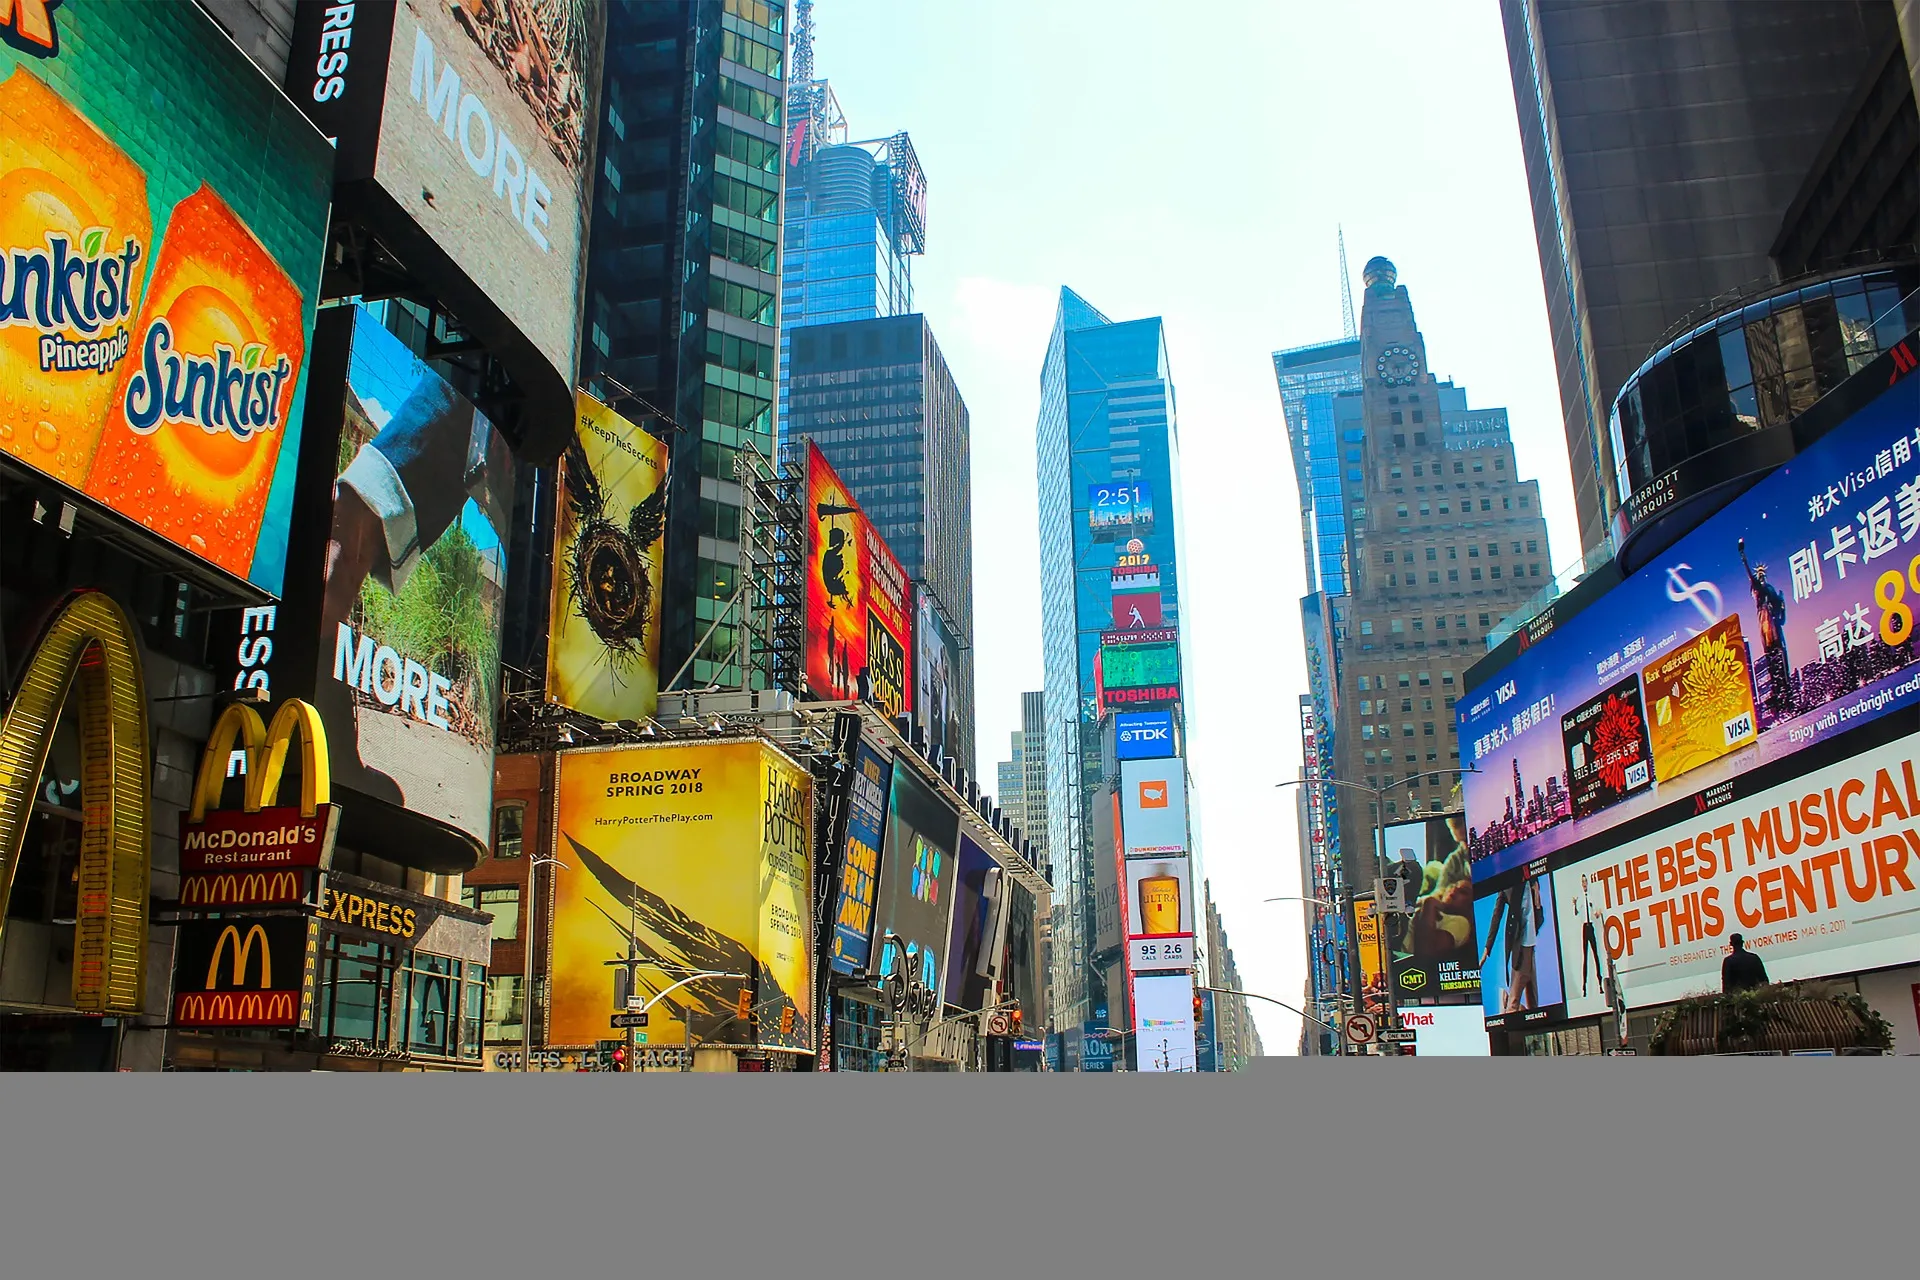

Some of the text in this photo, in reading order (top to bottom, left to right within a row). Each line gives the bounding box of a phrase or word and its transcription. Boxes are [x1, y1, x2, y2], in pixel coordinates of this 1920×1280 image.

[313, 0, 355, 102] RESS
[410, 25, 551, 254] MORE
[40, 328, 129, 375] Pineapple
[125, 322, 290, 436] Sunkist
[580, 414, 659, 471] #KeepTheSecrets
[1097, 486, 1141, 506] 2:51
[1629, 470, 1679, 510] MARRIOTT
[1632, 489, 1675, 524] MARQUIS
[1112, 564, 1159, 575] TOSHIBA
[1119, 554, 1150, 567] 2017
[1529, 607, 1555, 631] MARRIOTT
[1530, 620, 1554, 642] MARQUIS
[1815, 603, 1874, 664] 高达
[333, 621, 451, 731] MORE
[1104, 687, 1179, 703] TOSHIBA
[1496, 680, 1516, 704] VISA
[725, 714, 761, 723] LAMAR
[1789, 723, 1815, 742] Enjoy
[1816, 711, 1839, 732] with
[1839, 688, 1894, 721] Everbright
[1131, 728, 1168, 741] TDK
[1725, 718, 1750, 739] VISA
[609, 768, 702, 783] BROADWAY
[1627, 765, 1646, 784] VISA
[606, 782, 703, 798] SPRING 2018
[767, 765, 807, 826] HARRY
[1706, 781, 1733, 798] MARRIOTT
[1707, 792, 1732, 808] MARQUIS
[594, 813, 713, 827] HarryPotterThePlay.com
[184, 825, 316, 850] McDonald's
[764, 801, 809, 862] POTTER
[205, 849, 291, 864] Restaurant
[847, 836, 877, 878] COME
[1655, 822, 1735, 893] BEST
[1144, 893, 1177, 904] ULTRA
[315, 888, 416, 938] EXPRESS
[838, 896, 871, 935] AWAY
[1358, 922, 1374, 932] LION
[1604, 909, 1642, 960] OF
[1649, 886, 1725, 948] THIS
[1357, 933, 1377, 944] KING
[1754, 935, 1774, 949] YORK
[1774, 930, 1798, 943] TIMES
[1801, 926, 1820, 938] MAY
[1820, 923, 1829, 935] 6,
[1829, 919, 1846, 933] 2011
[1141, 944, 1182, 955] 95 2.6
[1669, 955, 1683, 966] BEN
[1683, 948, 1717, 963] BRANTLEY
[1443, 961, 1460, 971] LOVE
[1402, 974, 1423, 985] CMT
[1439, 971, 1462, 982] KELLIE
[1440, 981, 1472, 991] THURSDAYS
[632, 1016, 646, 1024] WAY
[1402, 1012, 1434, 1026] What
[1401, 1031, 1414, 1039] WAY
[495, 1051, 561, 1068] GITS
